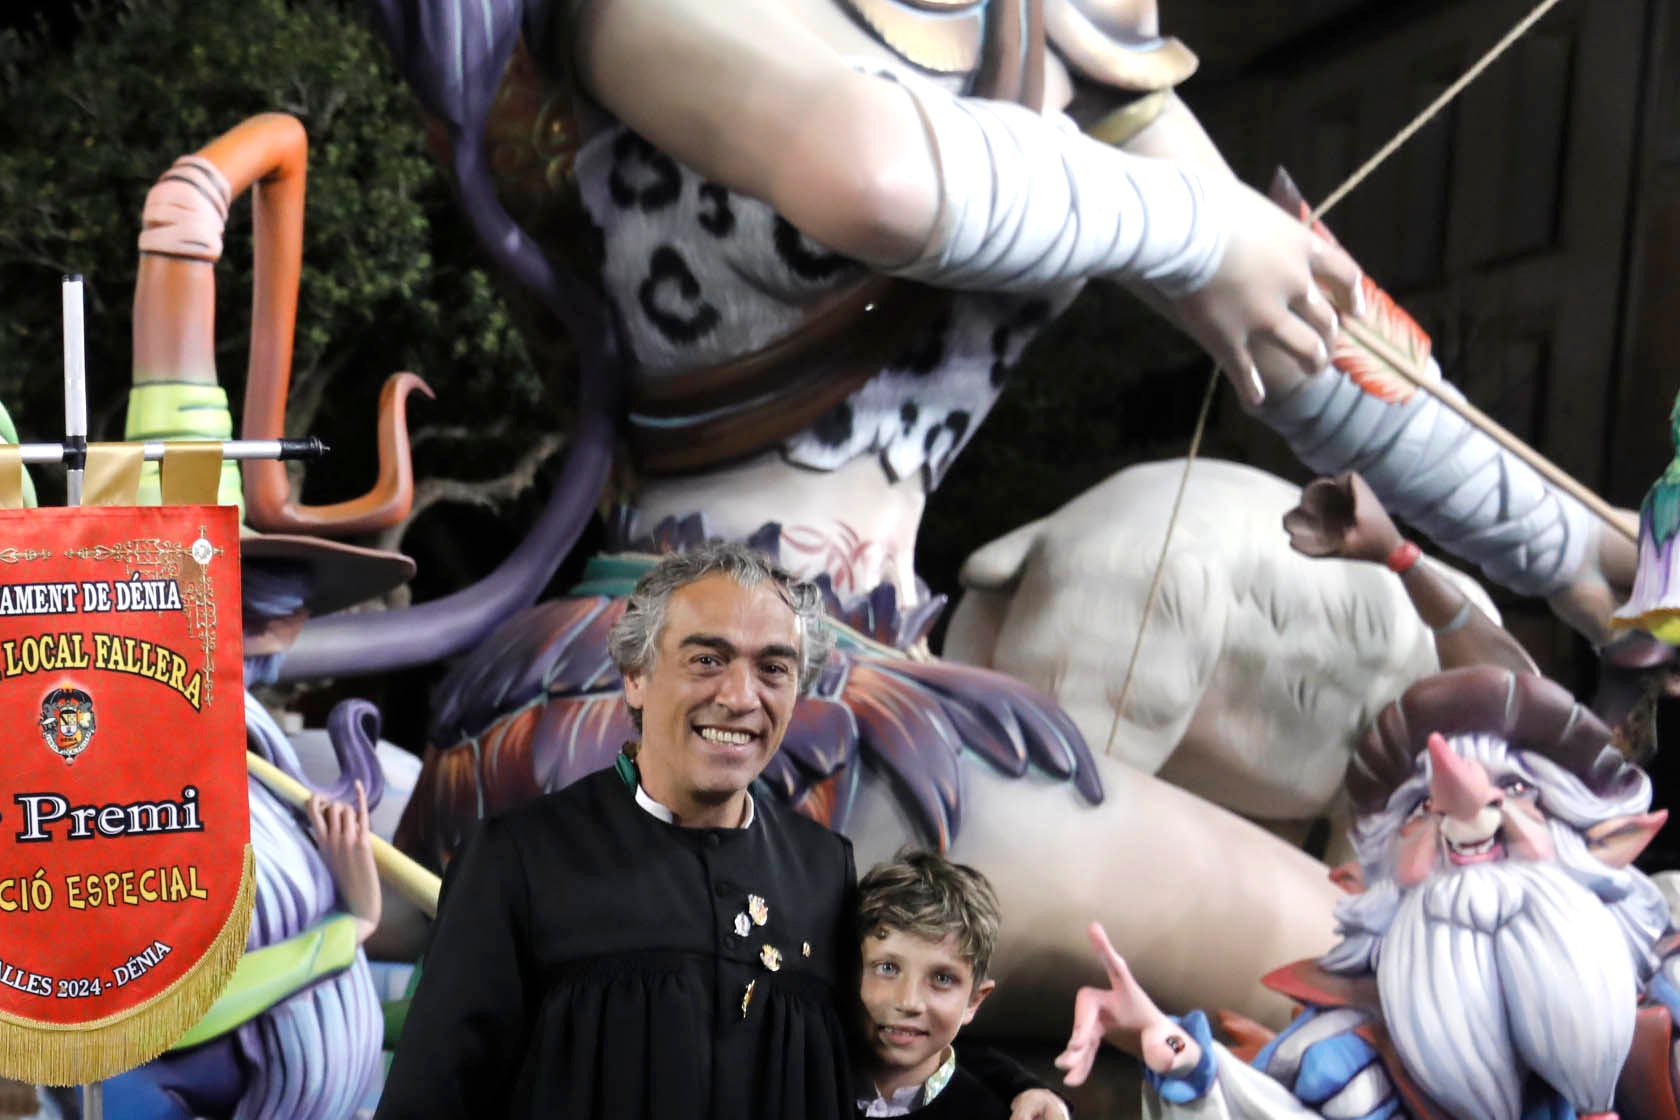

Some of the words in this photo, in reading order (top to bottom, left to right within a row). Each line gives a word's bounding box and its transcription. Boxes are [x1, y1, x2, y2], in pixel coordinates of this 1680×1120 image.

[82, 582, 113, 613] DE
[114, 574, 183, 612] DÉNIA
[4, 633, 88, 678] LOCAL
[93, 634, 204, 711] FALLERA
[14, 787, 204, 842] Premi
[66, 866, 208, 911] ESPECIAL
[56, 978, 102, 998] 2024
[114, 940, 173, 988] DÉNIA
